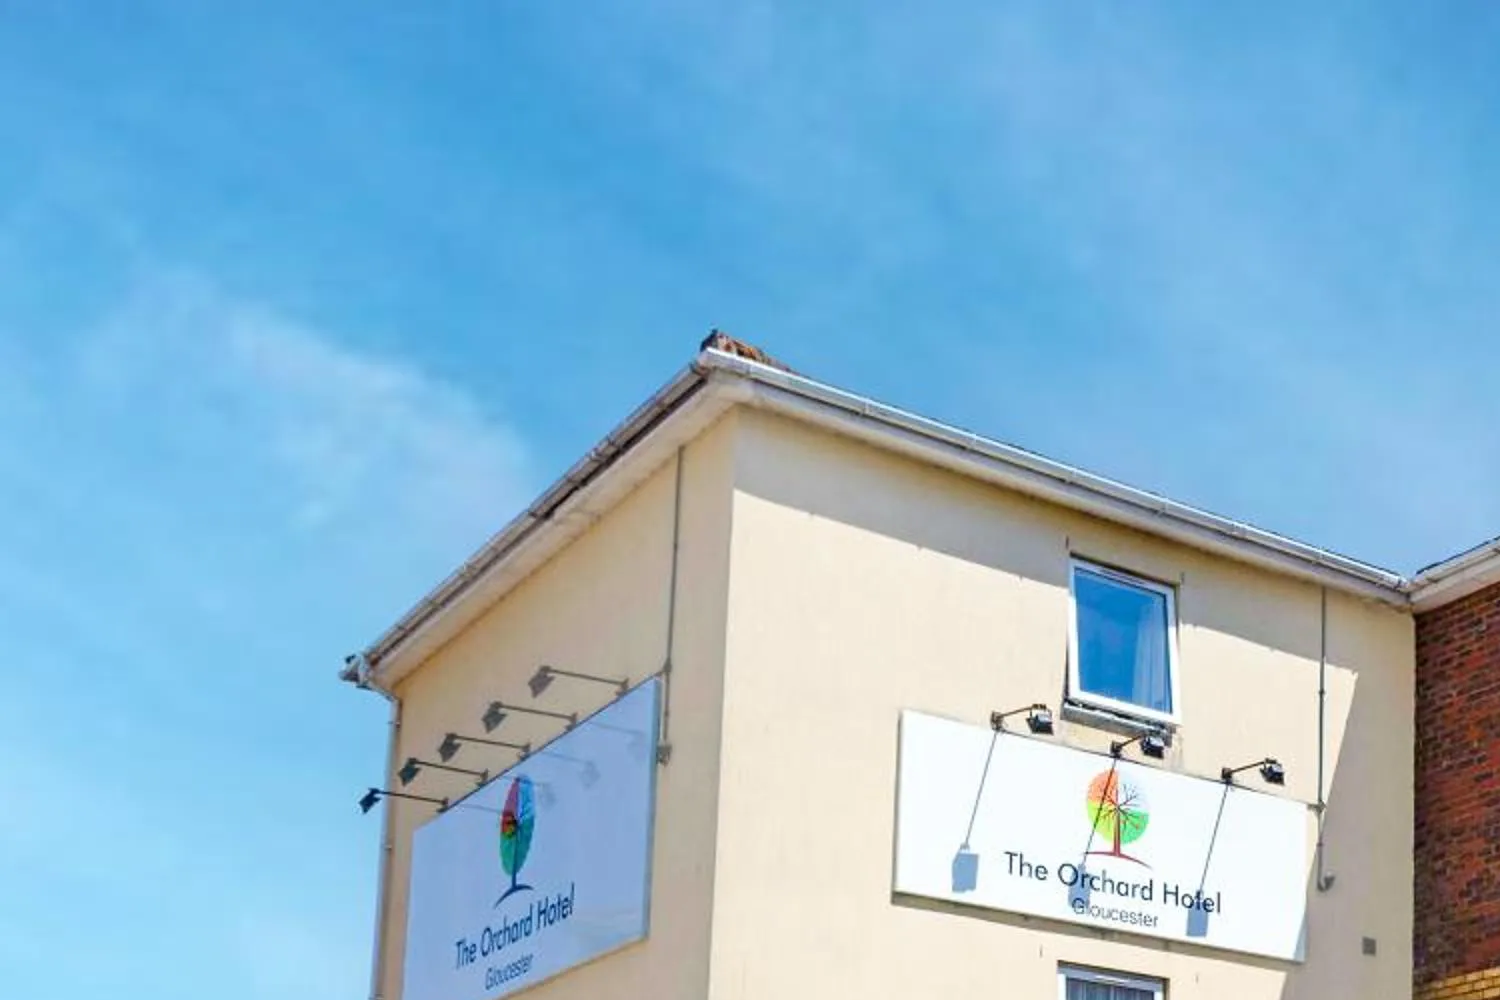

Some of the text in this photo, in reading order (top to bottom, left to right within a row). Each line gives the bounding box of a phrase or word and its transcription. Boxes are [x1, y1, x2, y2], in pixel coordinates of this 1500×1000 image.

[1004, 851, 1222, 914] The Orchard Hotel
[455, 882, 575, 971] The Orchard Hotel
[1070, 897, 1159, 928] Gloucester
[485, 953, 534, 991] Gloucester
